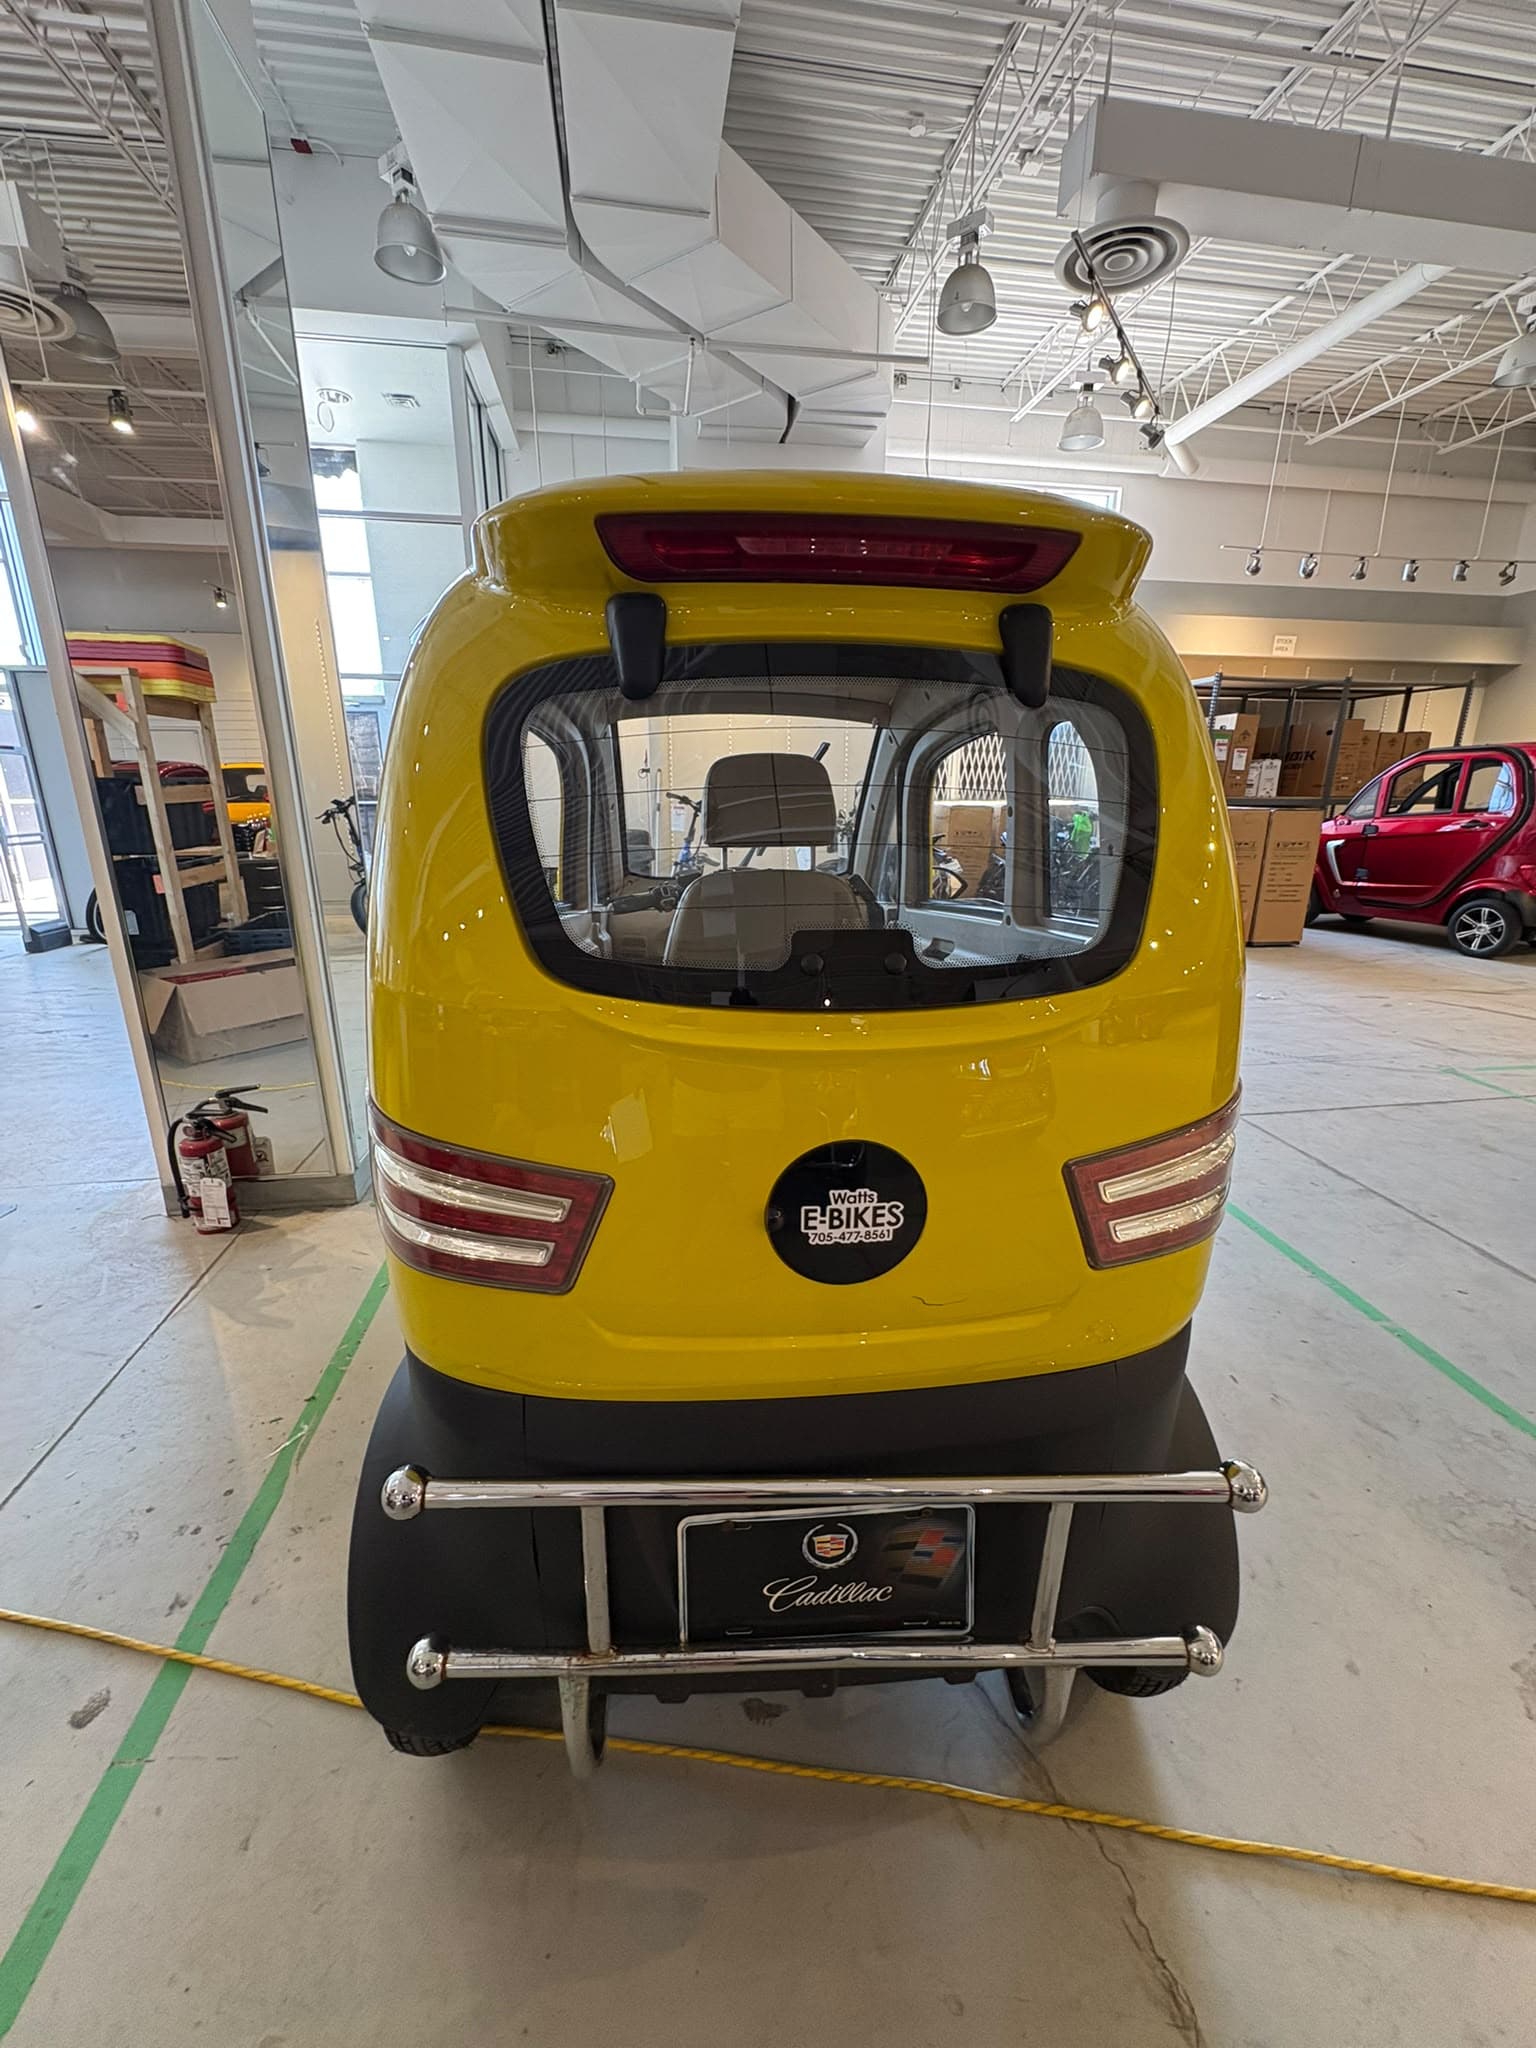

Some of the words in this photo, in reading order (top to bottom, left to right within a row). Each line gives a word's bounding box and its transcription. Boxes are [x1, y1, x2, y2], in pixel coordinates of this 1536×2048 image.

[831, 1190, 876, 1205] Watts
[803, 1203, 902, 1231] E-BIKES
[810, 1229, 891, 1243] 705-477-8561
[762, 1575, 893, 1613] Cadillac
